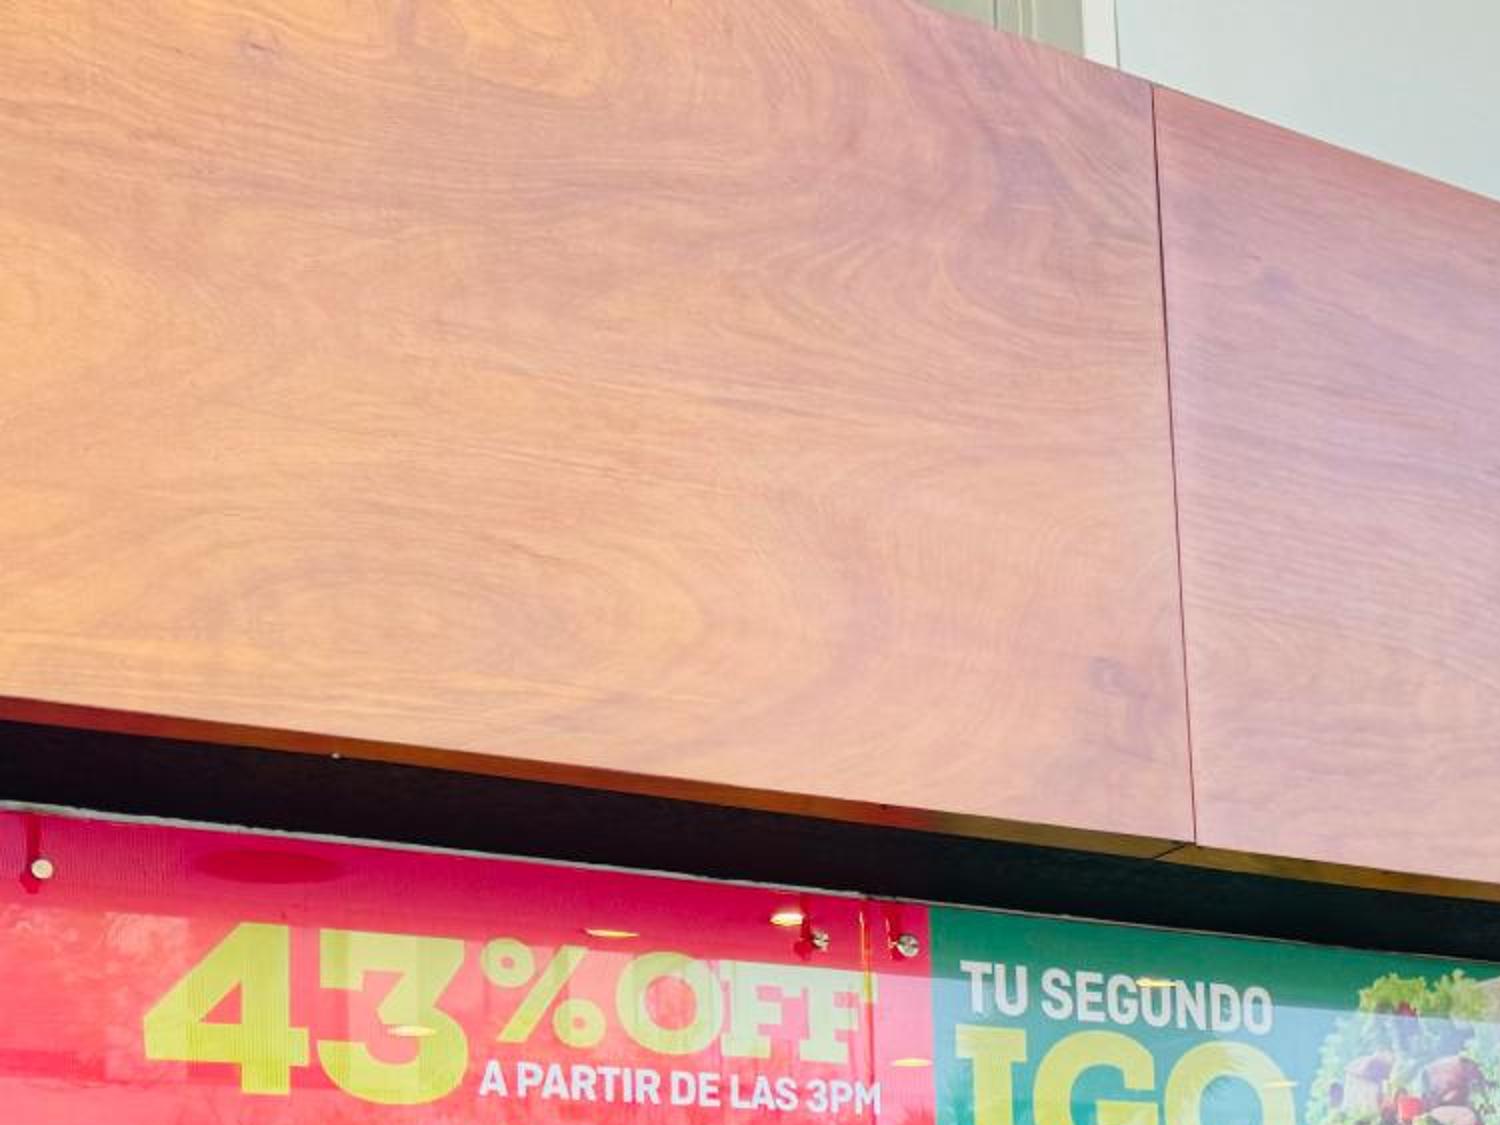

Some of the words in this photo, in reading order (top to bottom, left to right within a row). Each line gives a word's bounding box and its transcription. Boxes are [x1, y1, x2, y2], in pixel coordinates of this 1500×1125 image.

[959, 960, 1029, 1017] TU
[1041, 967, 1275, 1035] SEGUNDO
[479, 1060, 508, 1097] A
[516, 1062, 661, 1106] PARTIR
[670, 1071, 721, 1108] DE
[729, 1074, 800, 1114] LAS
[806, 1080, 882, 1117] 3PM
